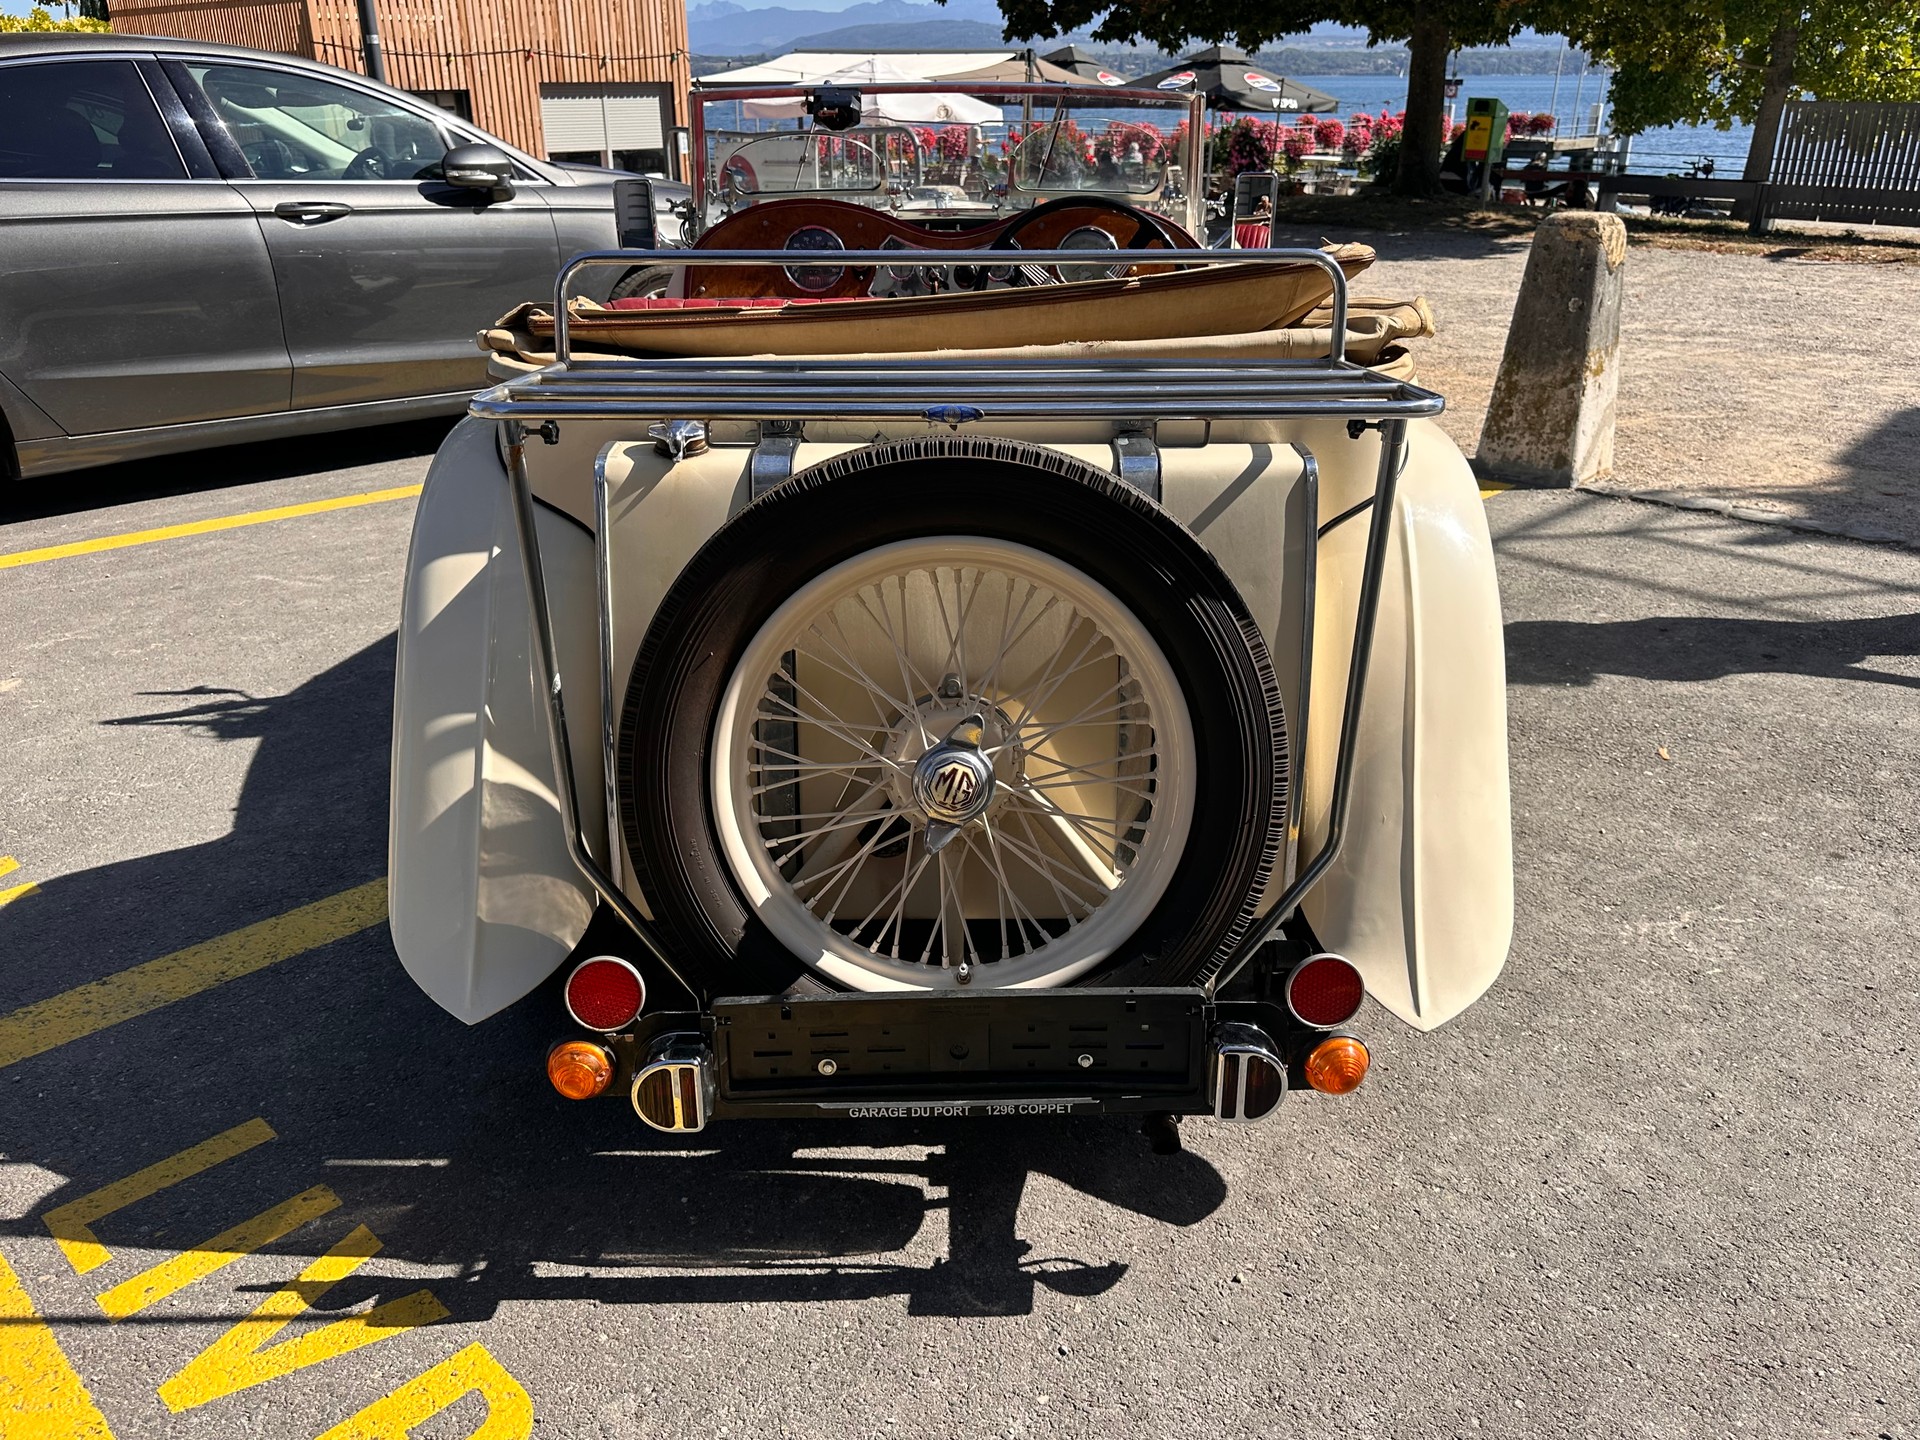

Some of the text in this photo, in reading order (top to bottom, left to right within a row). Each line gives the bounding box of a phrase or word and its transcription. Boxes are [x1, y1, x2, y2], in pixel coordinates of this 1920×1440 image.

[935, 768, 976, 808] MG
[848, 1102, 1074, 1118] GARAGE DU PORT 1296 COPPET
